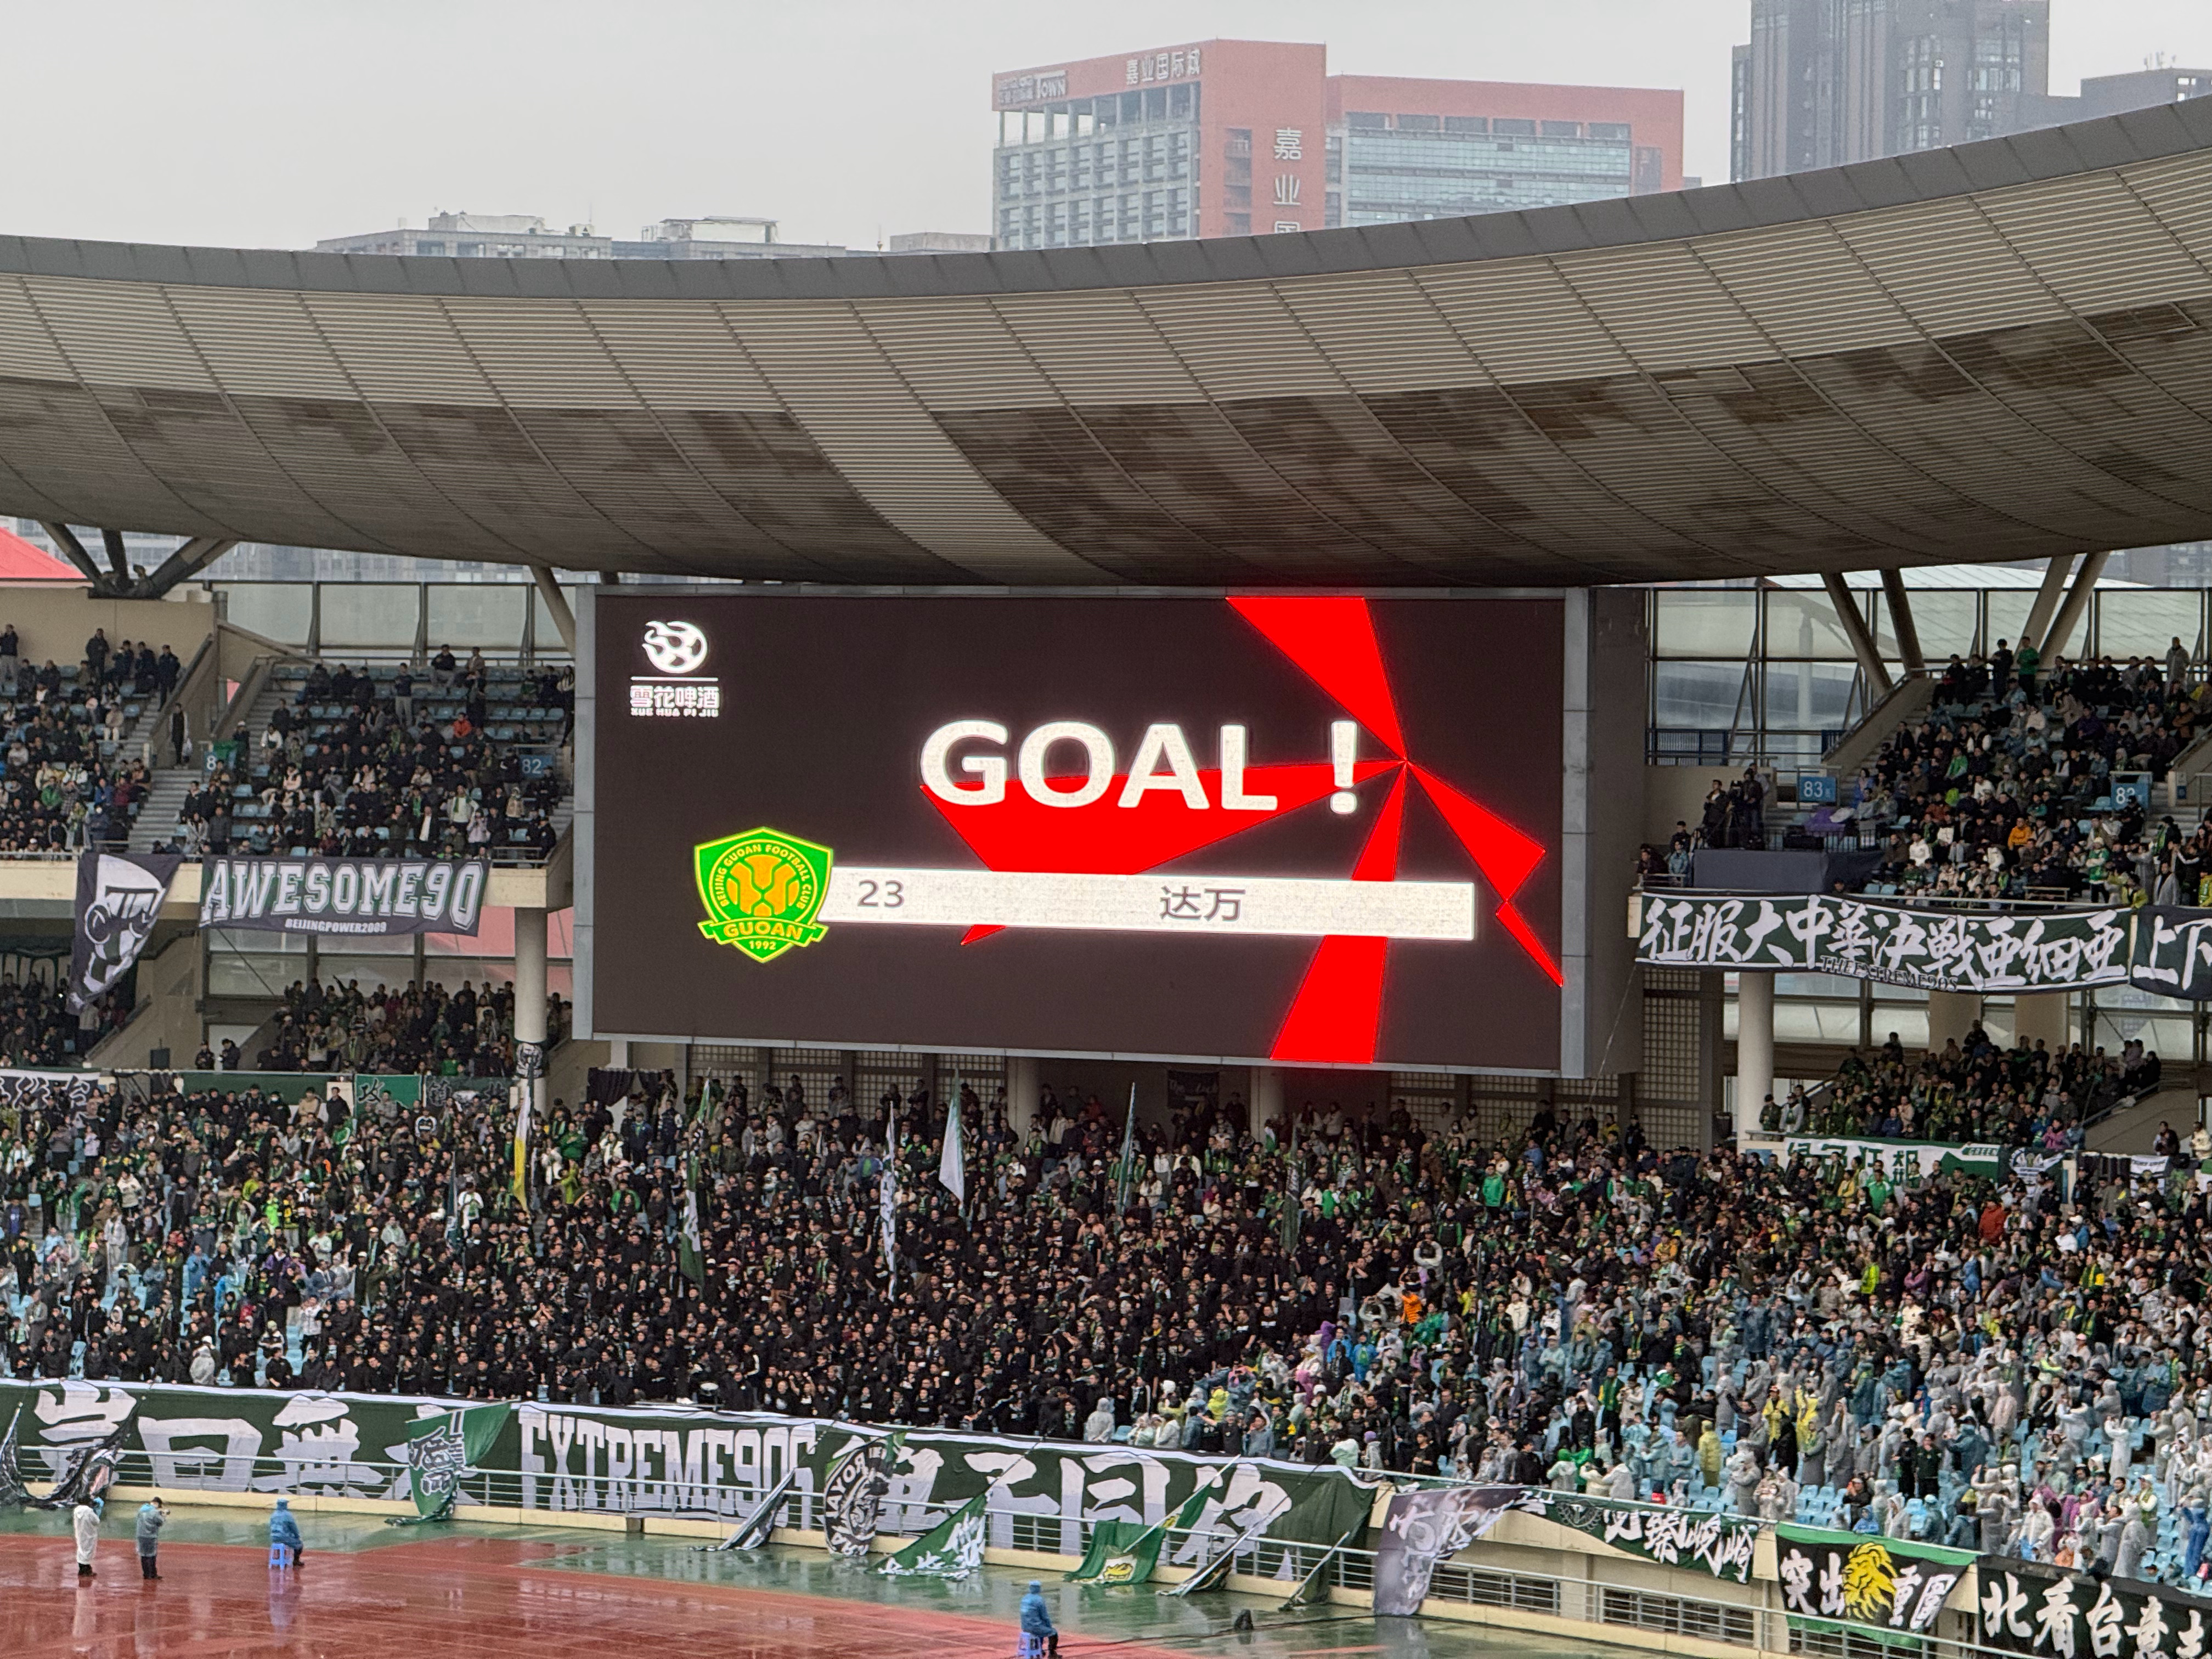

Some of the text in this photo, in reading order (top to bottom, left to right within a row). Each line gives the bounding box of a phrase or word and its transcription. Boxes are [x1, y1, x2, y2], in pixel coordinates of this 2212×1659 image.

[630, 685, 720, 709] 雪花啤酒
[656, 708, 680, 717] HUA
[698, 709, 719, 717] JIU
[522, 758, 541, 774] 82
[920, 719, 1278, 811] GOAL
[714, 844, 812, 910] BEIJING GUOAN FOOTBALL CLUB
[199, 859, 483, 931] AWESOME90
[857, 879, 905, 908] 23
[1159, 884, 1246, 922] 达万
[723, 921, 803, 940] GUOAN
[749, 940, 776, 950] 1992
[518, 1405, 816, 1531] EXTREME90S
